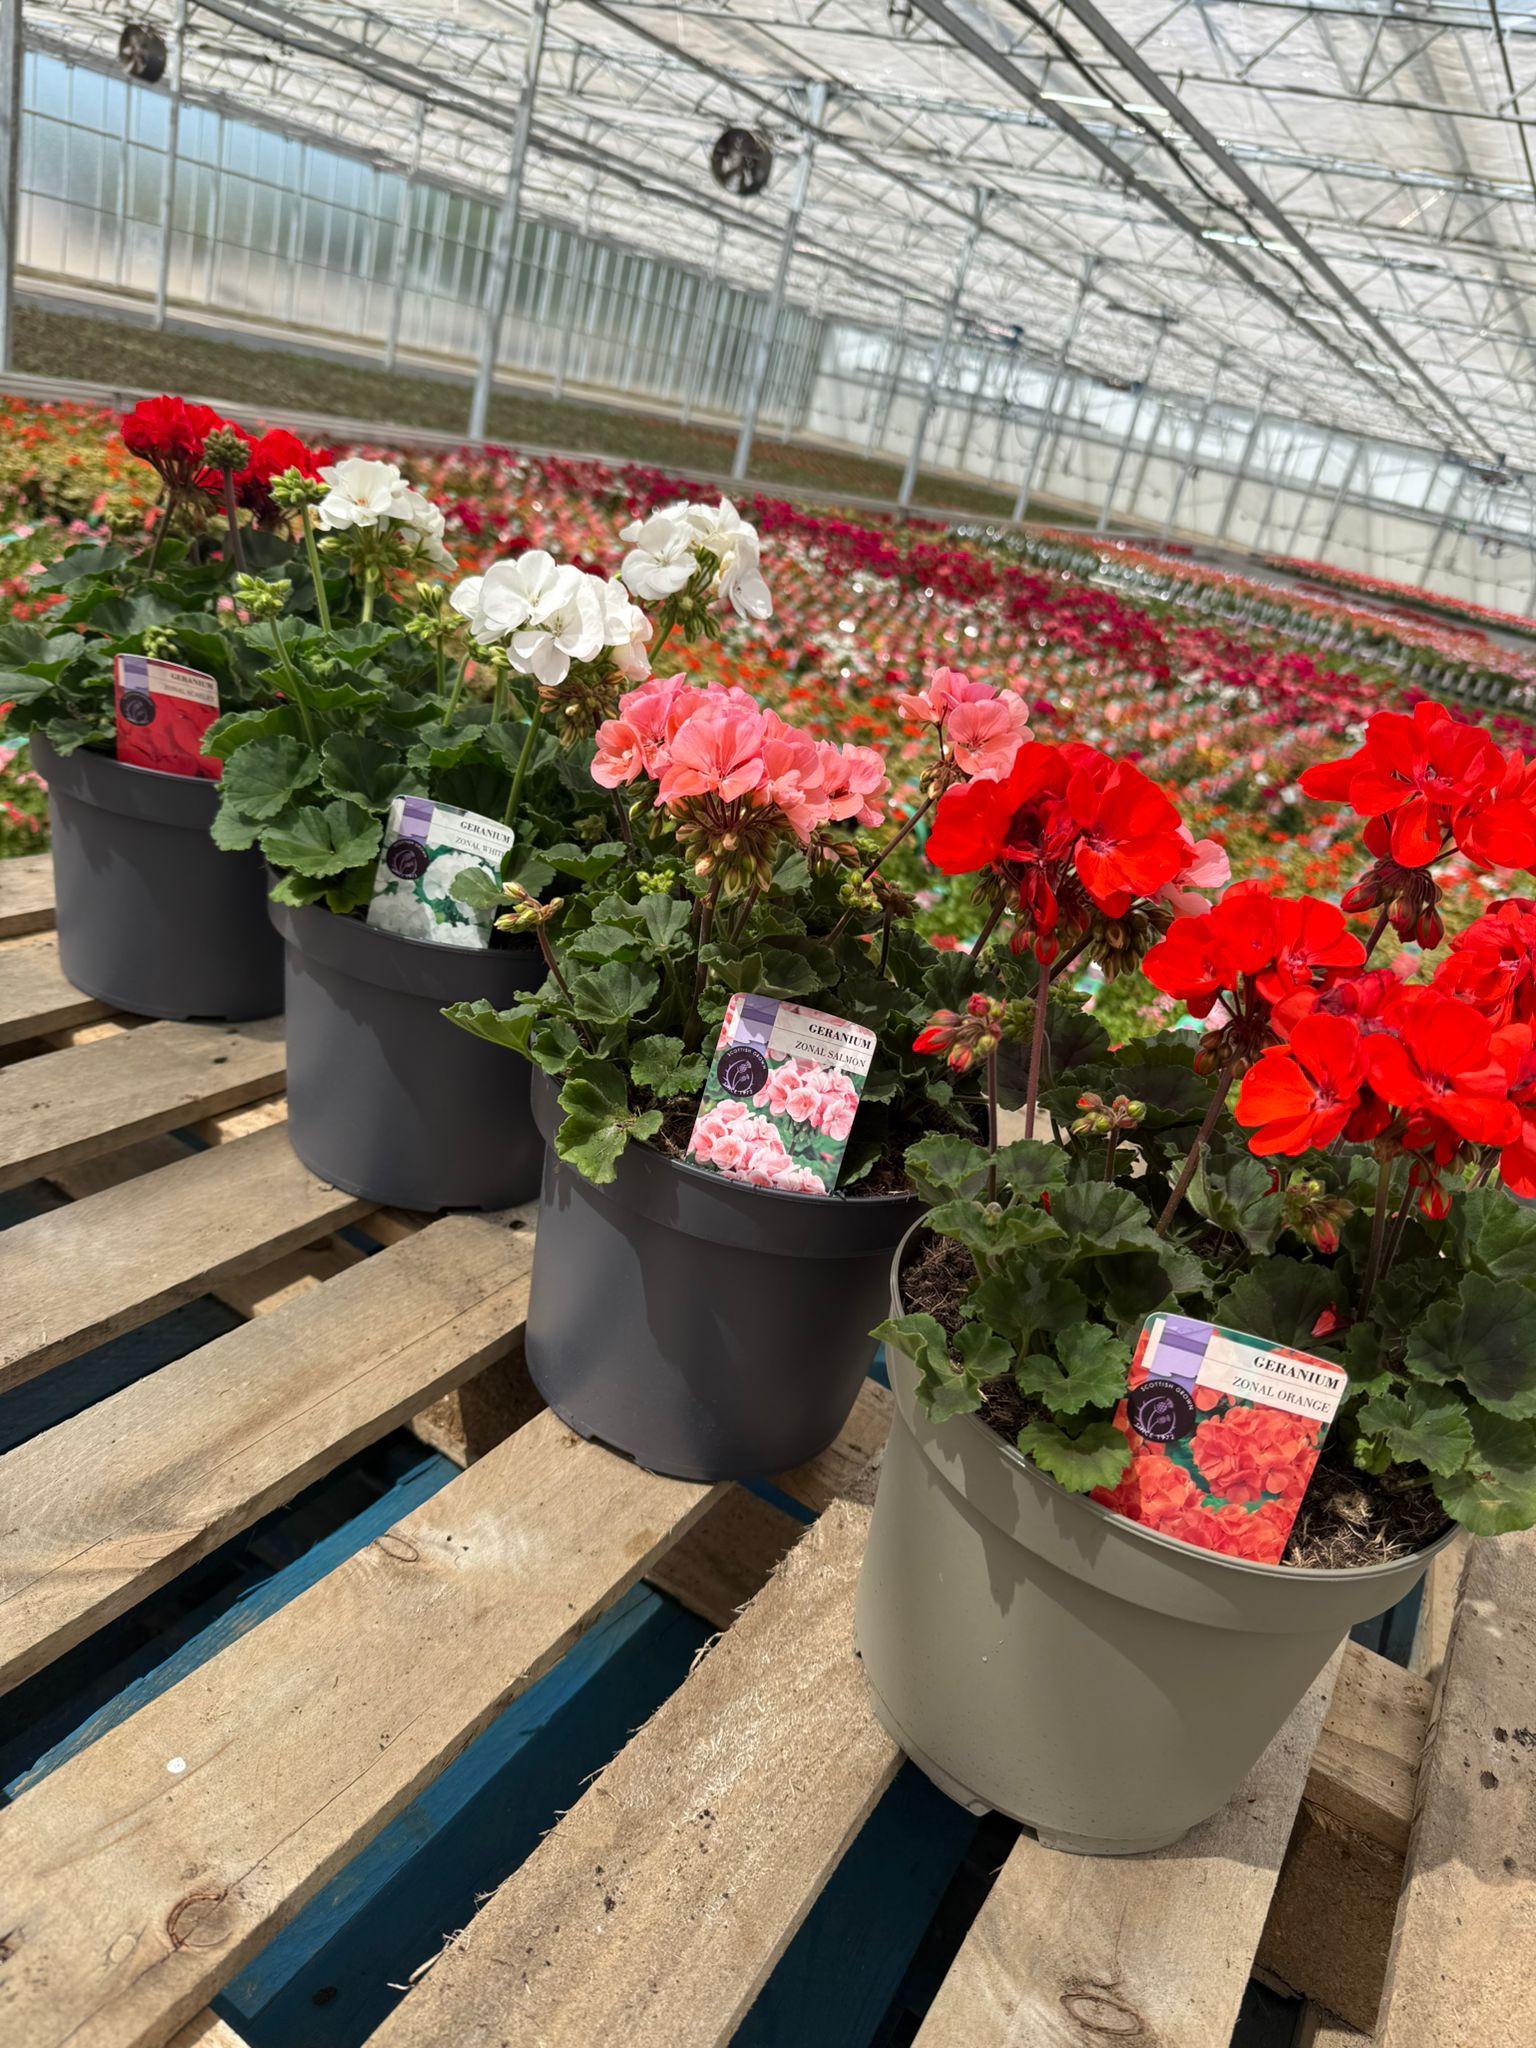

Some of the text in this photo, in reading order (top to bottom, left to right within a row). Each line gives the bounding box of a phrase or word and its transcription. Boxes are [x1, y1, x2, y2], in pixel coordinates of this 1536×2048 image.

[170, 672, 213, 690] GERANIUM
[455, 835, 480, 850] ZONAL
[460, 821, 511, 844] GERANIUM
[808, 1023, 871, 1050] GERANIUM
[726, 1047, 752, 1057] SCOTTISH
[794, 1040, 866, 1068] ZONAL SALMON
[1253, 1356, 1339, 1390] GERANIUM
[1140, 1381, 1195, 1411] SCOTTISH GROWN
[1232, 1376, 1331, 1414] ZONAL ORANGE
[1134, 1422, 1155, 1438] SINCE
